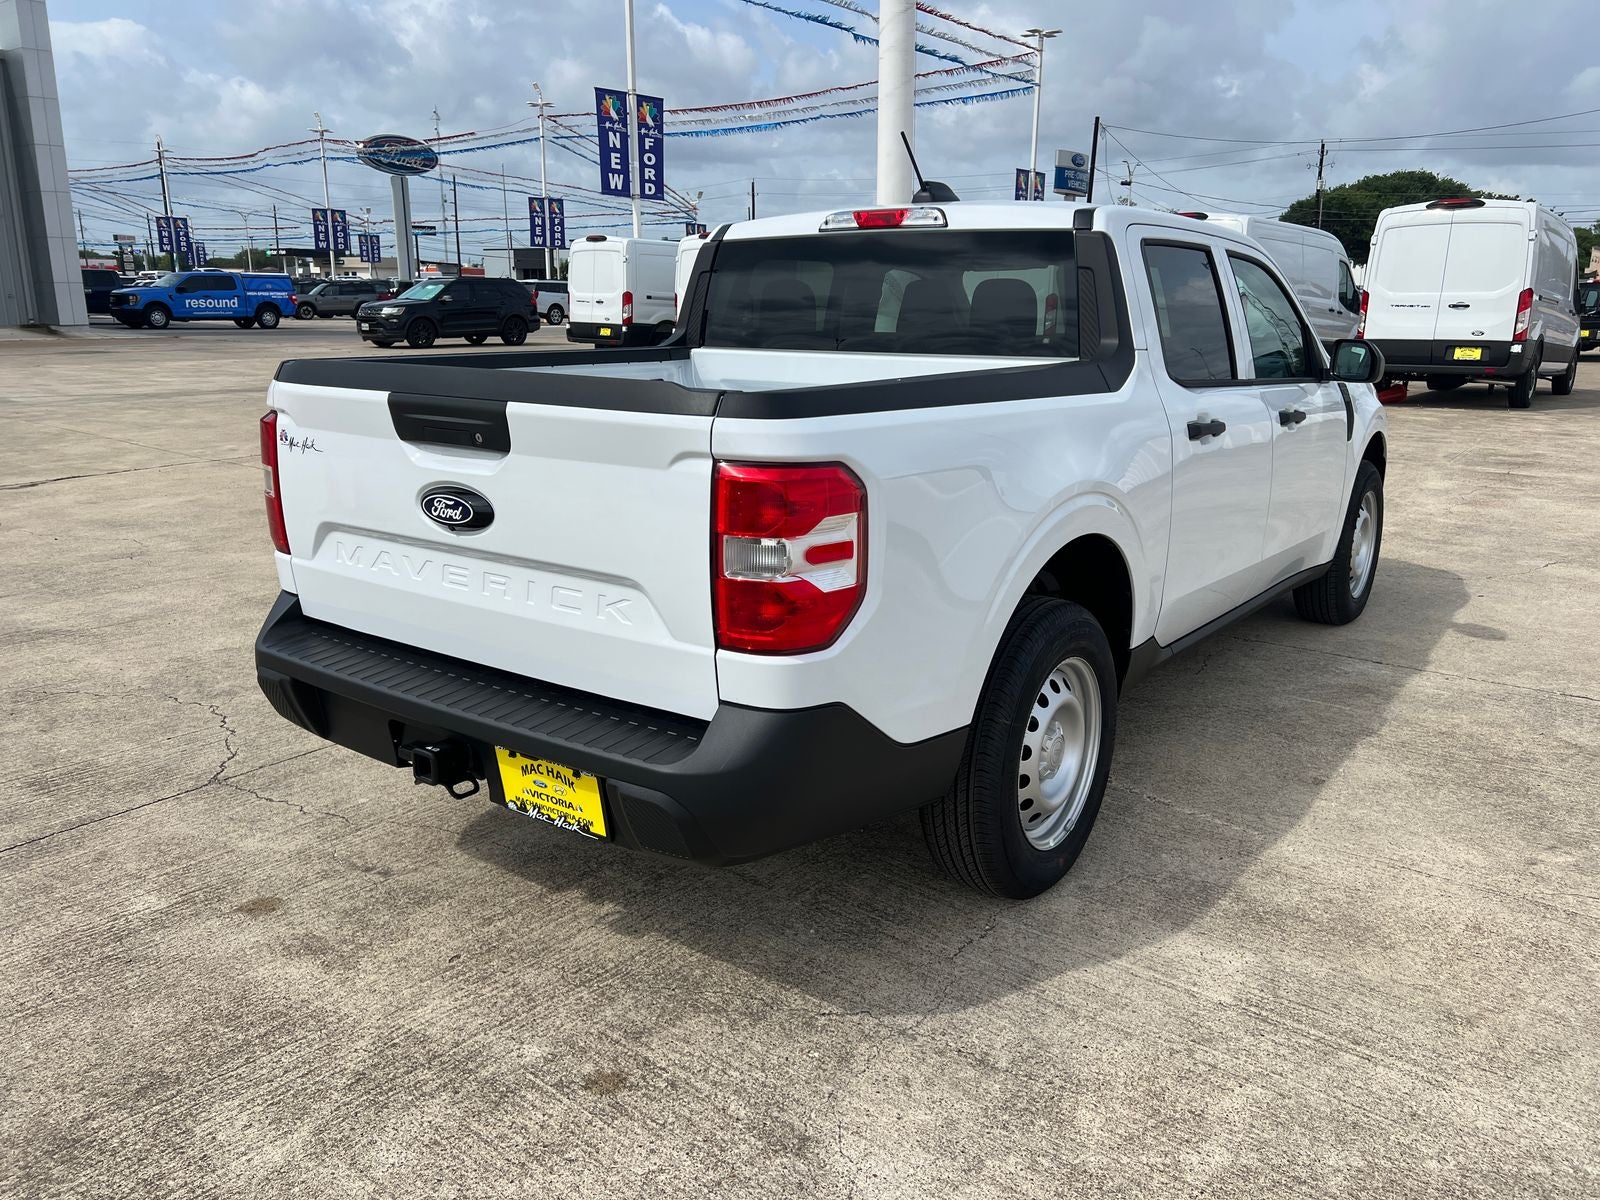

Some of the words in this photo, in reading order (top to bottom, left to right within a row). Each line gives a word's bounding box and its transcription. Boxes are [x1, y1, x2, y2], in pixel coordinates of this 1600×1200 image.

[608, 131, 624, 190] NEW
[643, 137, 656, 195] FORD
[161, 230, 171, 251] NEW
[179, 231, 187, 252] FORD
[318, 225, 327, 249] NEW
[336, 226, 345, 250] FORD
[534, 217, 544, 245] NEW
[554, 218, 562, 246] FORD
[185, 296, 238, 308] resound
[431, 494, 463, 521] Ford
[335, 541, 634, 626] MAVERICK
[520, 763, 544, 778] MAC
[545, 766, 577, 793] HAIK
[528, 789, 576, 811] VICTORIA
[526, 806, 553, 824] Mac
[553, 816, 596, 840] Haik
